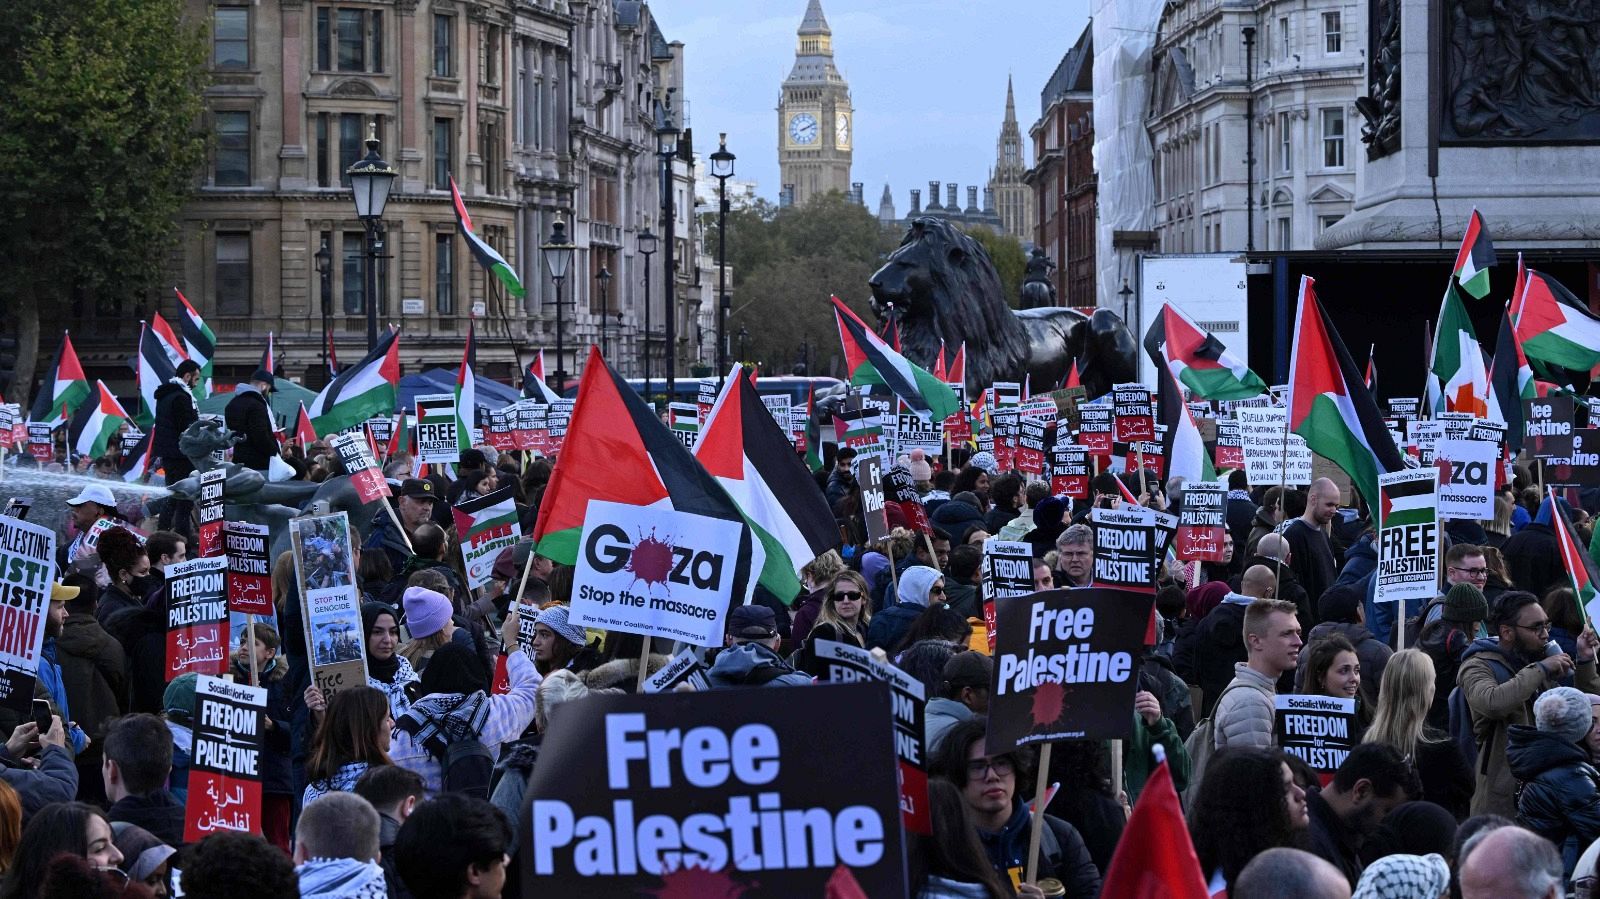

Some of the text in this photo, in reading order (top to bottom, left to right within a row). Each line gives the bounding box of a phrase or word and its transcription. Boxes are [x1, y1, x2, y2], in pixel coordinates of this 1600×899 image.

[1116, 392, 1148, 402] FREEDOM
[520, 410, 546, 418] FREEDOM
[1082, 411, 1108, 420] FREEDOM
[1116, 406, 1151, 416] PALESTINE
[1242, 412, 1264, 422] SUELLA
[518, 420, 547, 430] PALESTINE
[1022, 424, 1044, 438] FREEDOM
[1080, 424, 1110, 432] PALESTINE
[1242, 425, 1253, 434] HAS
[1254, 426, 1276, 434] NOTHING
[418, 424, 456, 441] FREE
[898, 432, 942, 441] PALESTINE
[420, 440, 456, 450] PALESTINE
[1020, 437, 1044, 450] PALESTINE
[1243, 436, 1255, 445] THE
[1056, 453, 1084, 462] FREEDOM
[1054, 466, 1086, 475] PALESTINE
[202, 482, 223, 500] FREEDOM
[1184, 493, 1222, 506] FREEDOM
[1441, 494, 1488, 504] massacre
[200, 504, 224, 523] PALESTINE
[1118, 514, 1143, 524] Worker
[1180, 512, 1224, 524] PALESTINE
[470, 524, 513, 550] FREE
[1097, 527, 1146, 551] FREEDOM
[1188, 530, 1212, 542] الحرية
[1380, 524, 1435, 560] FREE
[226, 535, 264, 552] FREEDOM
[1182, 542, 1216, 554] لفلسطين
[1112, 550, 1120, 560] for
[174, 563, 196, 574] Socialist
[226, 556, 268, 574] PALESTINE
[994, 559, 1030, 580] FREEDOM
[1096, 558, 1150, 582] PALESTINE
[1380, 556, 1434, 576] PALESTINE
[1404, 572, 1434, 582] OCCUPATION
[172, 573, 224, 599] FREEDOM
[233, 578, 260, 592] الحرية
[190, 594, 200, 602] for
[231, 593, 266, 606] لفلسطين
[315, 594, 348, 605] STOP THE
[580, 584, 717, 620] Stop the massacre
[169, 600, 227, 628] PALESTINE
[314, 602, 350, 614] GENOCIDE
[582, 614, 596, 623] Stop
[624, 620, 654, 630] Coalition
[1028, 602, 1094, 644] Free
[176, 629, 218, 650] الحرية
[172, 646, 224, 671] لفلسطين
[997, 643, 1132, 695] Palestine
[1288, 698, 1344, 711] Socialist Worker
[1284, 714, 1348, 738] FREEDOM
[1314, 736, 1324, 747] for
[605, 712, 780, 790] Free
[198, 808, 250, 832] لفلسطين
[532, 792, 884, 876] Palestine
